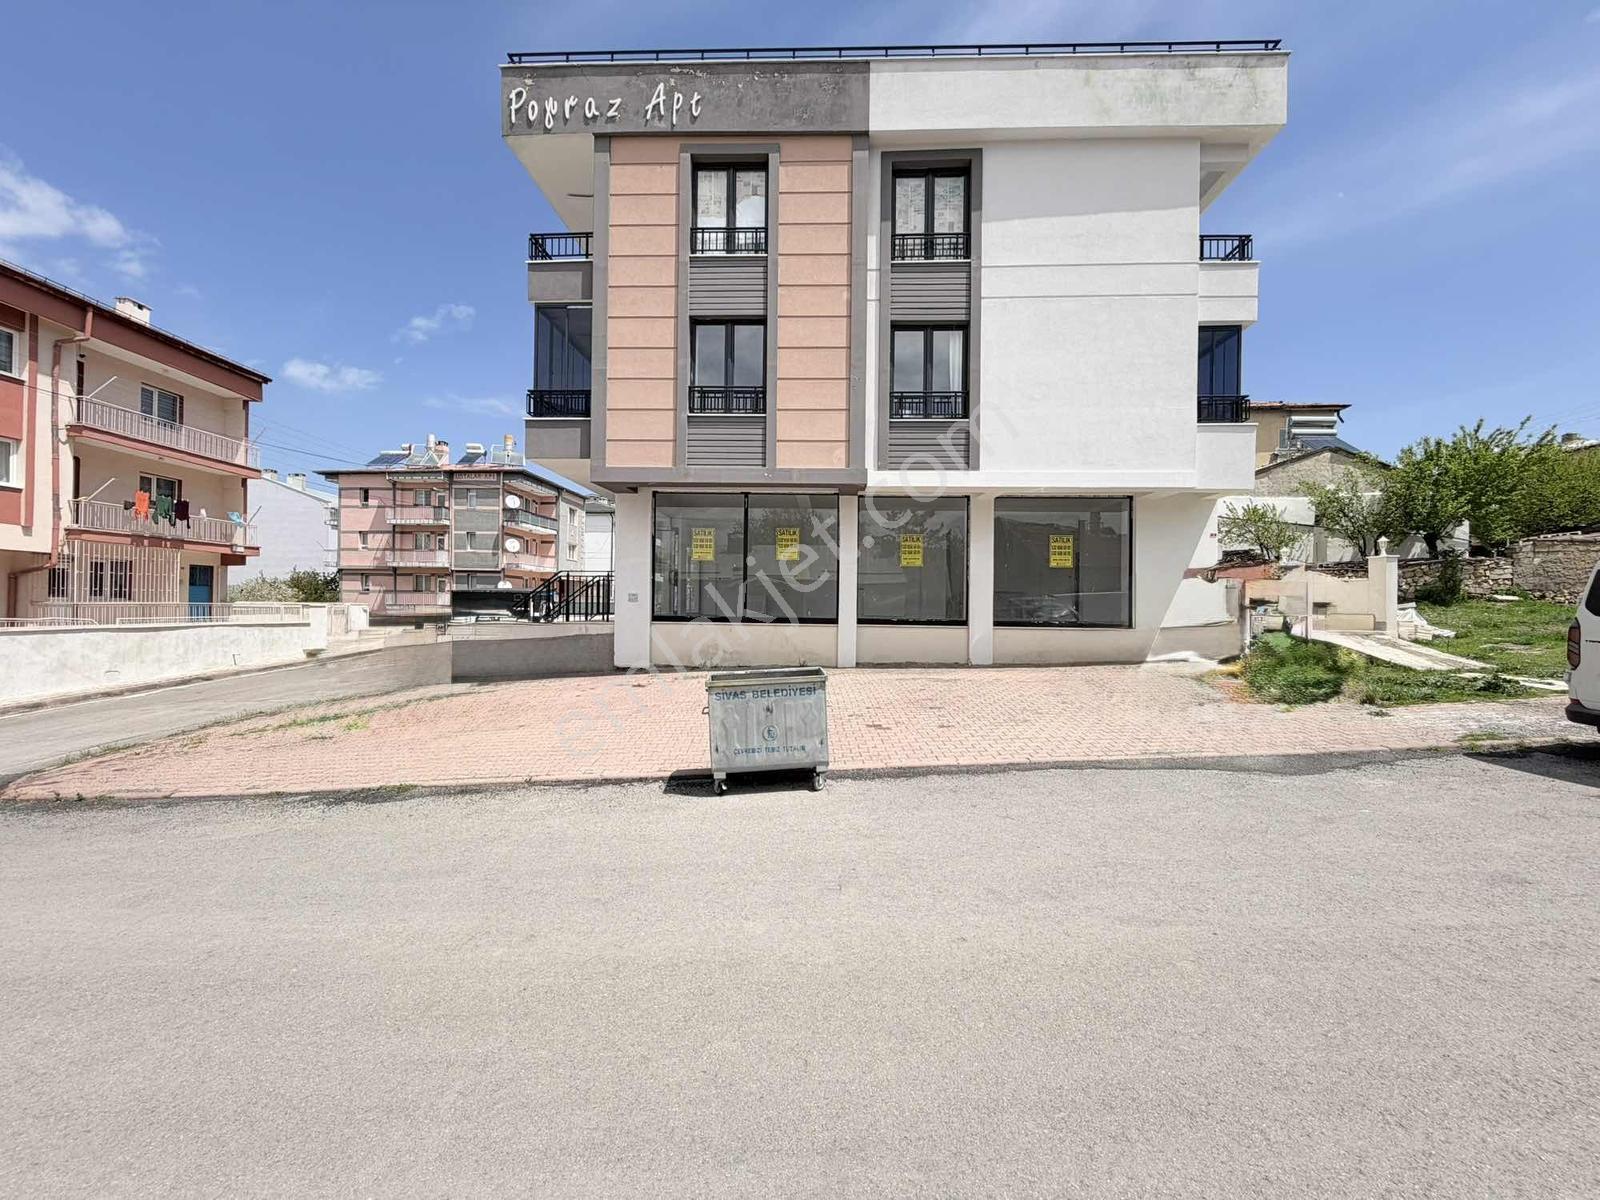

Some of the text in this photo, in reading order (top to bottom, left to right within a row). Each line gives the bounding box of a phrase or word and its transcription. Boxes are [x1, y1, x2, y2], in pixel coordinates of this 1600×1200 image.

[509, 82, 701, 130] Poyraz Apt
[714, 684, 816, 701] SİVAS BELEDİYESİ
